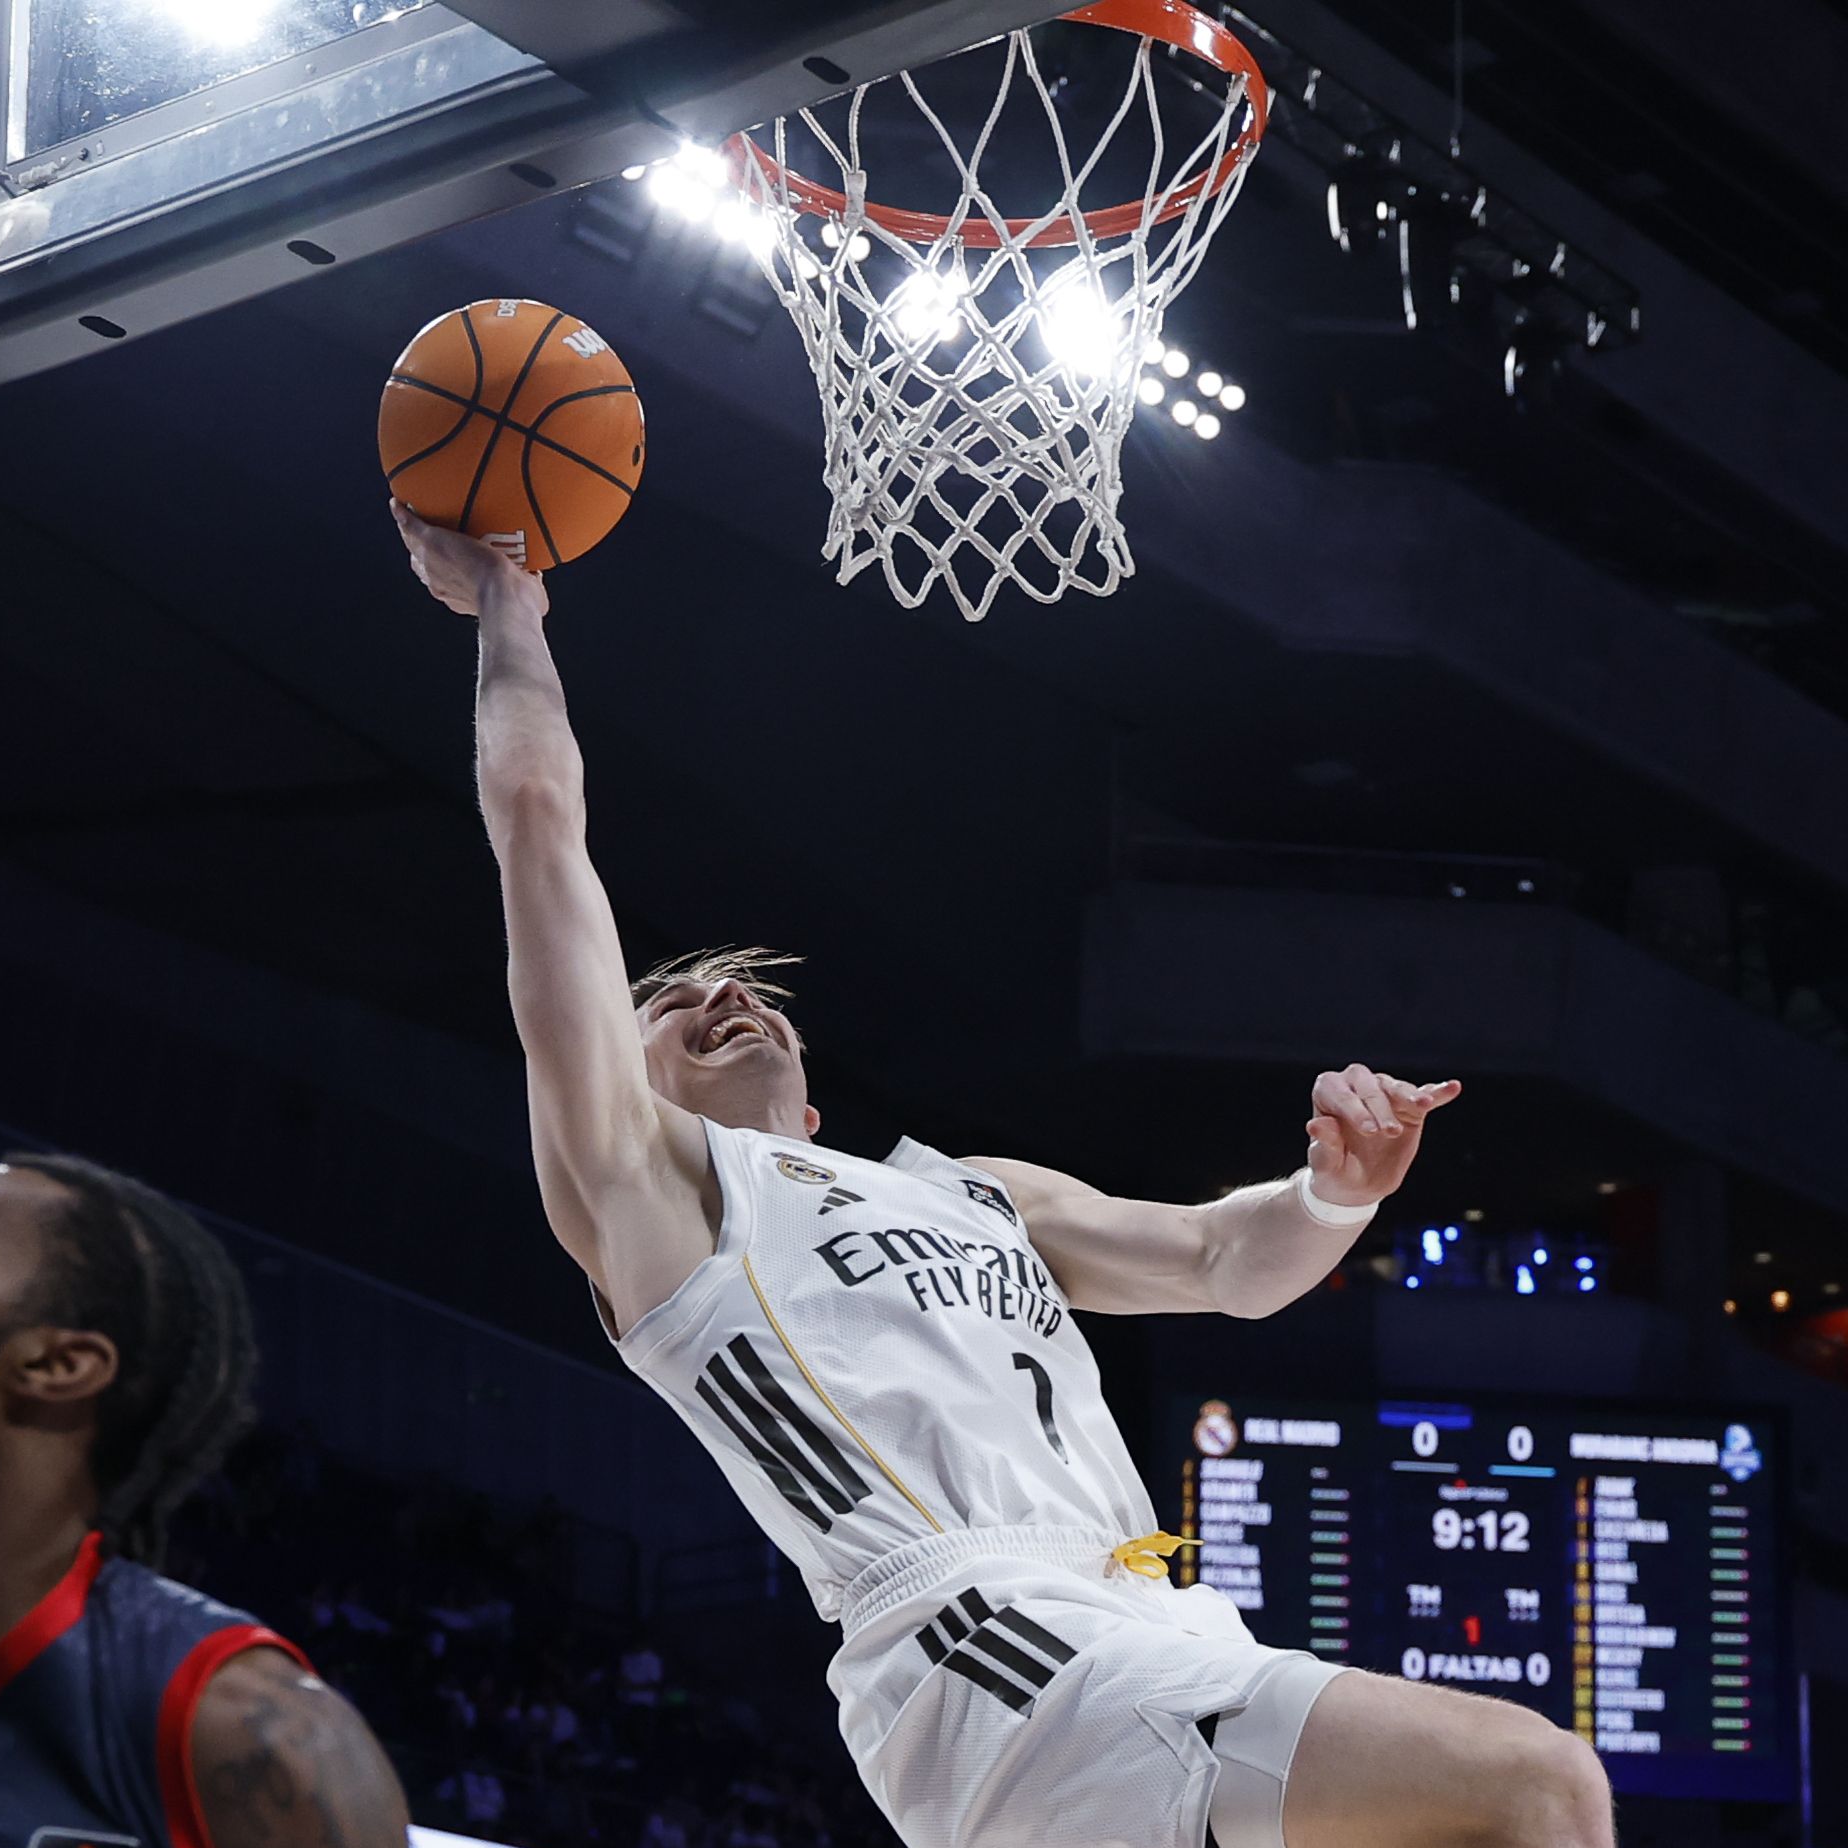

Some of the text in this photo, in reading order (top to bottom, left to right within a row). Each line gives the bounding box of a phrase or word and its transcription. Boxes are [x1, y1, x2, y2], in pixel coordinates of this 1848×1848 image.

[812, 1227, 1061, 1304] Emirate
[905, 1266, 1062, 1339] FLY BETTER
[1412, 1421, 1439, 1458] 0
[1507, 1425, 1534, 1462] 0
[1431, 1507, 1530, 1552] 9:12
[1463, 1615, 1481, 1646] 1
[1402, 1647, 1551, 1687] 0 FALTAS 0
